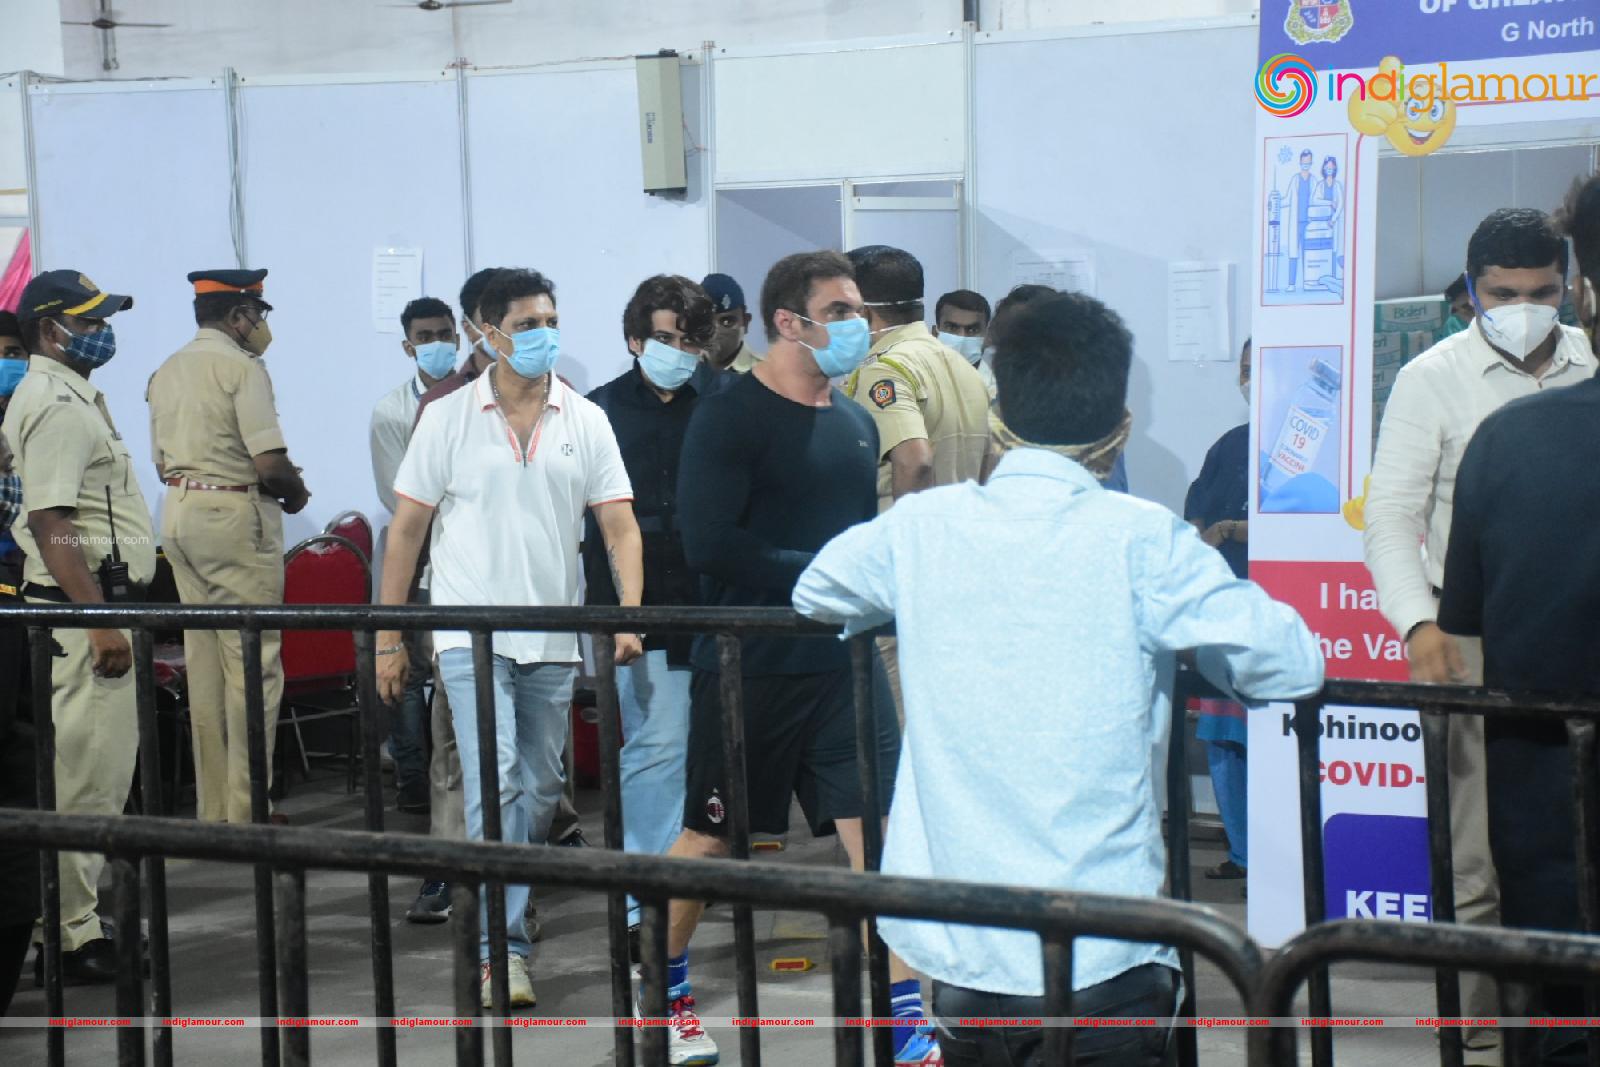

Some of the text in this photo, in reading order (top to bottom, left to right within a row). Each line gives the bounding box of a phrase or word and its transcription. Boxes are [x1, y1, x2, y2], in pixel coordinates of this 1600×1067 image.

[1501, 17, 1594, 42] G North
[1290, 416, 1320, 441] COVID
[1293, 433, 1306, 449] 19
[1320, 582, 1378, 610] I ha
[1314, 632, 1408, 661] he Va
[1282, 713, 1421, 742] Khinoo
[1346, 889, 1433, 923] KEE
